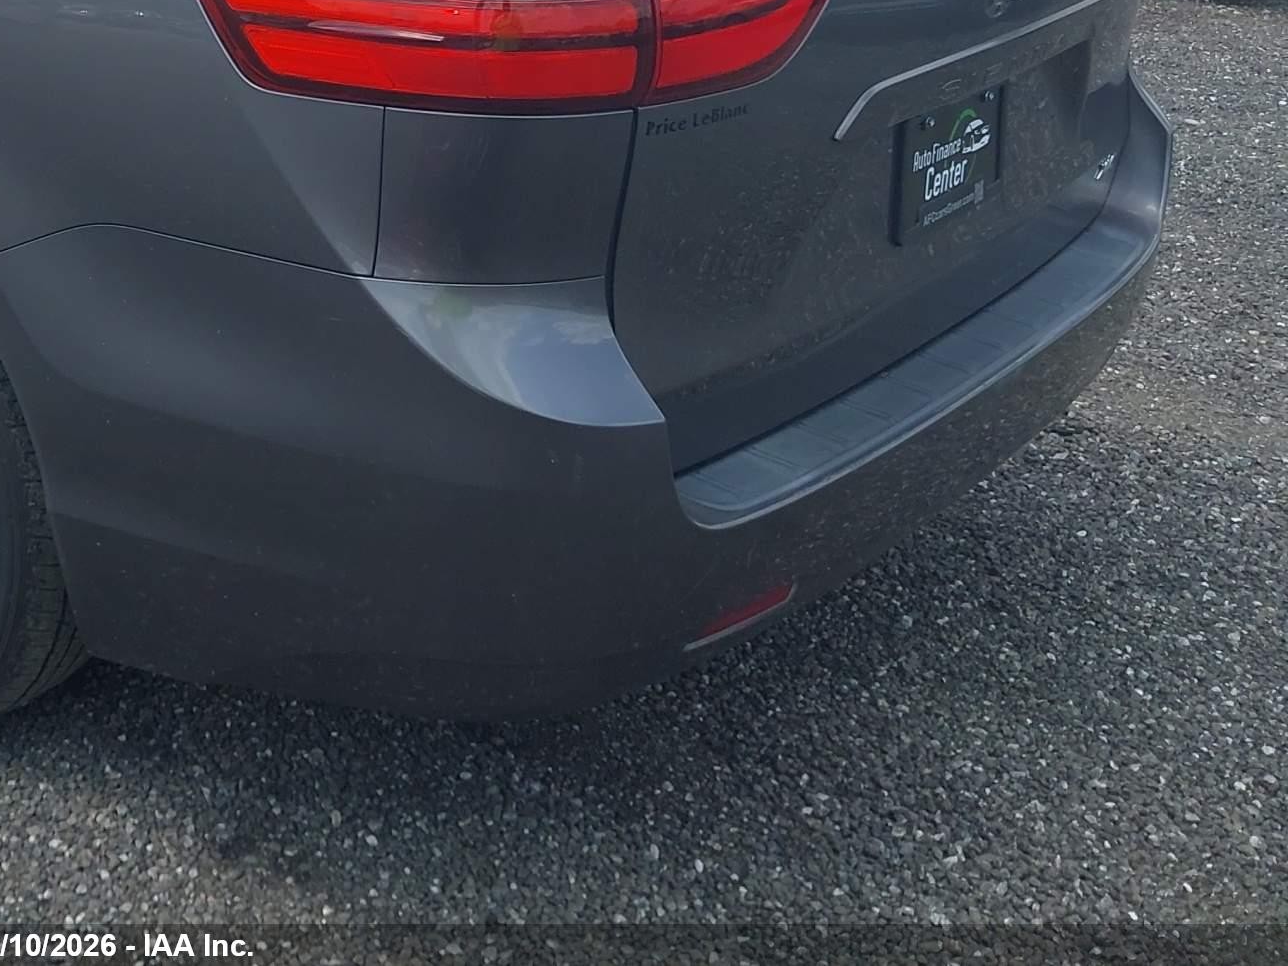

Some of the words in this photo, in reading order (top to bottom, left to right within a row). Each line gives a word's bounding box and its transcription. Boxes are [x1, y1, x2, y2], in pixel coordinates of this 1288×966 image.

[645, 118, 687, 136] Price
[693, 103, 750, 127] LeBlanc
[924, 158, 968, 201] Center
